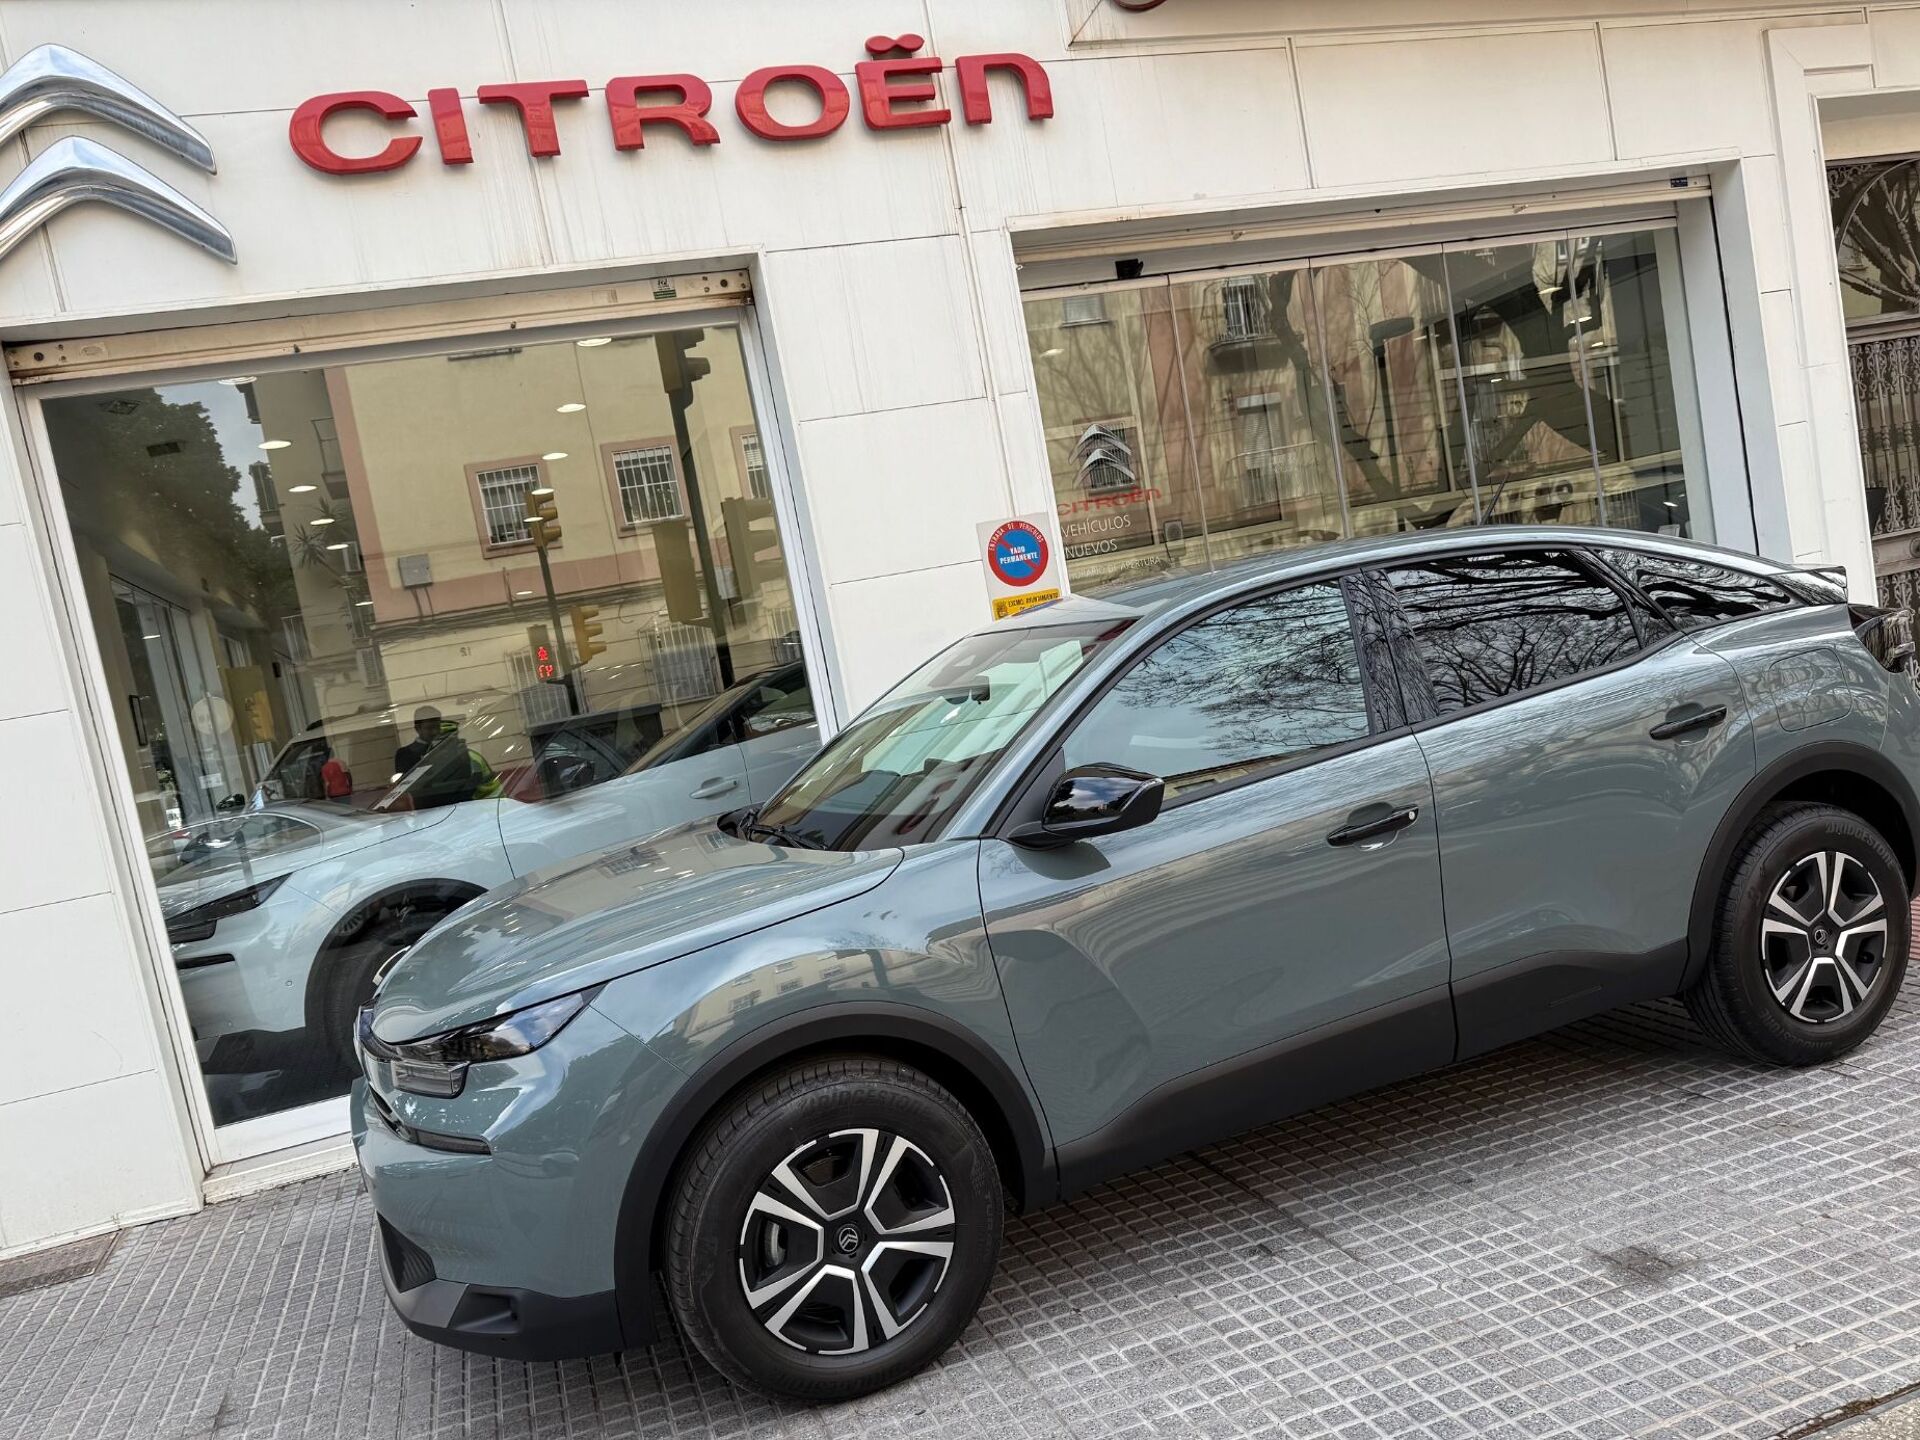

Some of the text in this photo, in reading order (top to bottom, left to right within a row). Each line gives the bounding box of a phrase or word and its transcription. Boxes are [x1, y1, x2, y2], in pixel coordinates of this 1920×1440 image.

[289, 34, 1054, 175] CITROËN
[1061, 514, 1131, 538] VEHÍCULOS
[1000, 551, 1039, 564] PERMANENTE
[1010, 545, 1026, 555] VADO
[1065, 538, 1118, 560] NUEVOS
[1120, 556, 1161, 571] APERTURA
